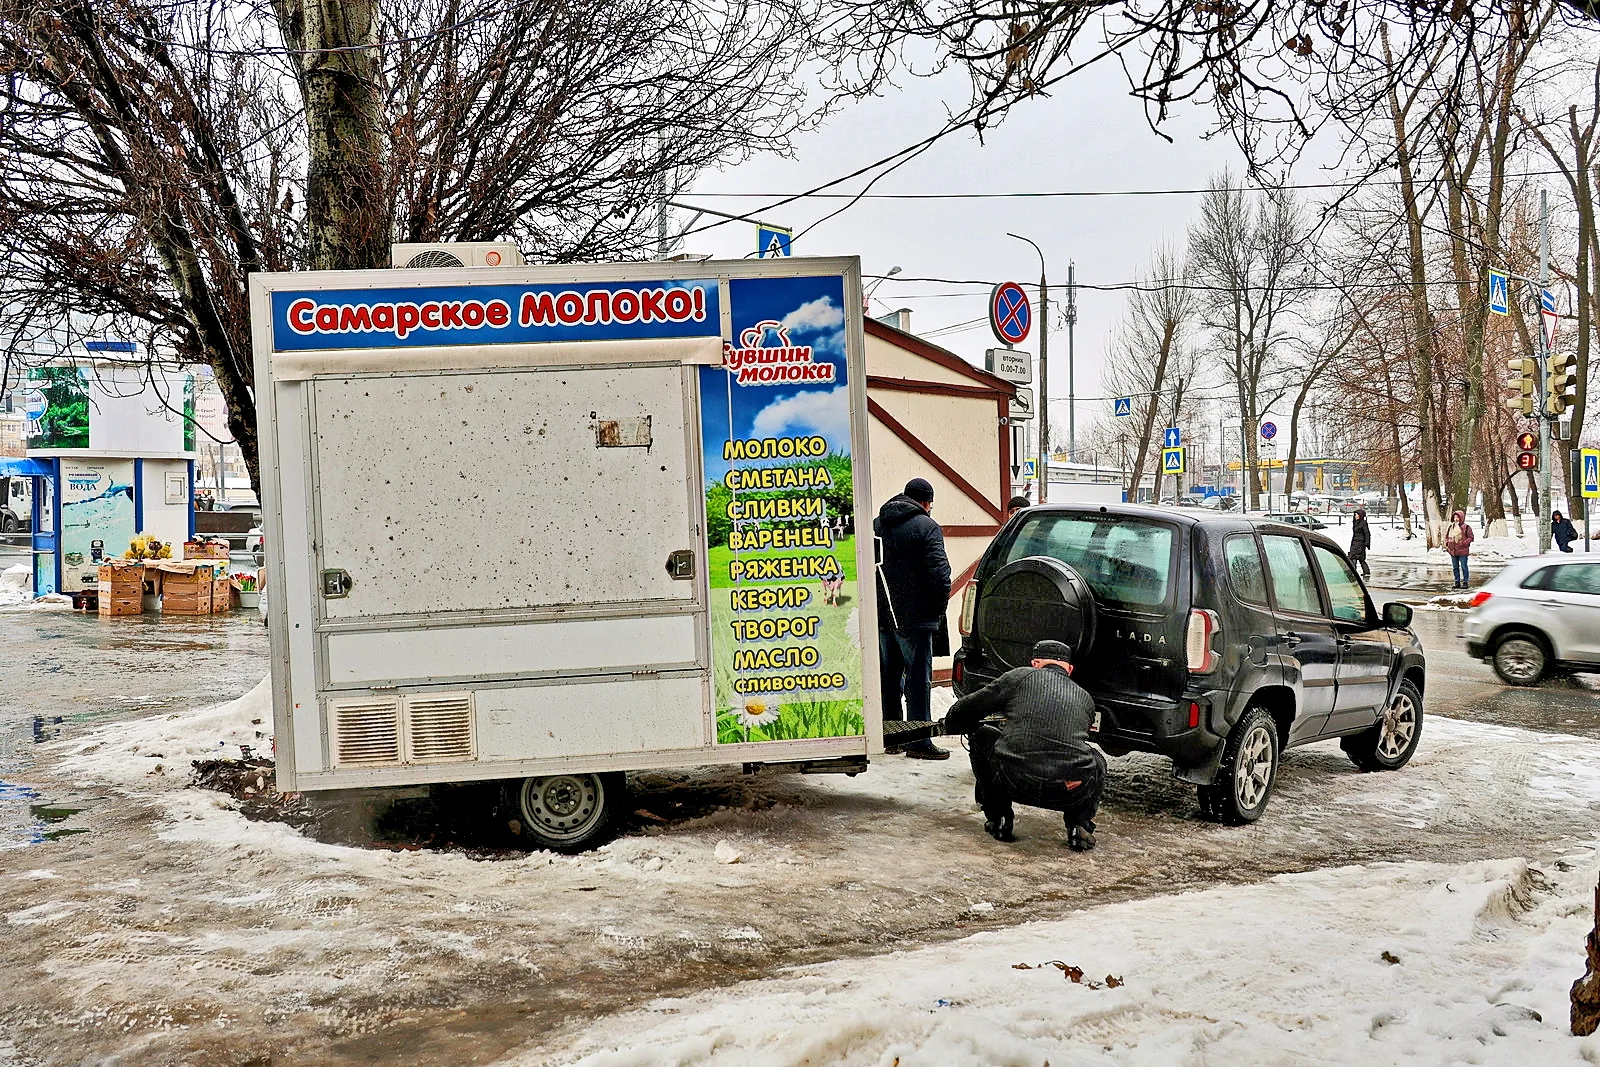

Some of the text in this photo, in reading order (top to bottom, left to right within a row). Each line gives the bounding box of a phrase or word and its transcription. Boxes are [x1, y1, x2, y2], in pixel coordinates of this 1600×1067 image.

[288, 288, 706, 338] Самарское МОЛОКО!
[1000, 363, 1027, 374] 0.00-7.00
[1002, 355, 1024, 363] вторник
[738, 363, 832, 383] молока
[723, 436, 827, 460] МОЛОКО
[1521, 455, 1536, 467] 31
[69, 483, 97, 491] ВОДА
[724, 466, 831, 490] СМЕТАНА
[726, 497, 823, 520] СЛИВКИ
[728, 526, 833, 551] ВАРЕНЕЦ
[729, 555, 839, 581] РЯЖЕНКА
[731, 587, 810, 611] КЕФИР
[731, 616, 821, 641] ТВОРОГ
[1116, 629, 1167, 645] LADA
[733, 646, 819, 670] МАСЛО
[734, 673, 845, 694] сливочное
